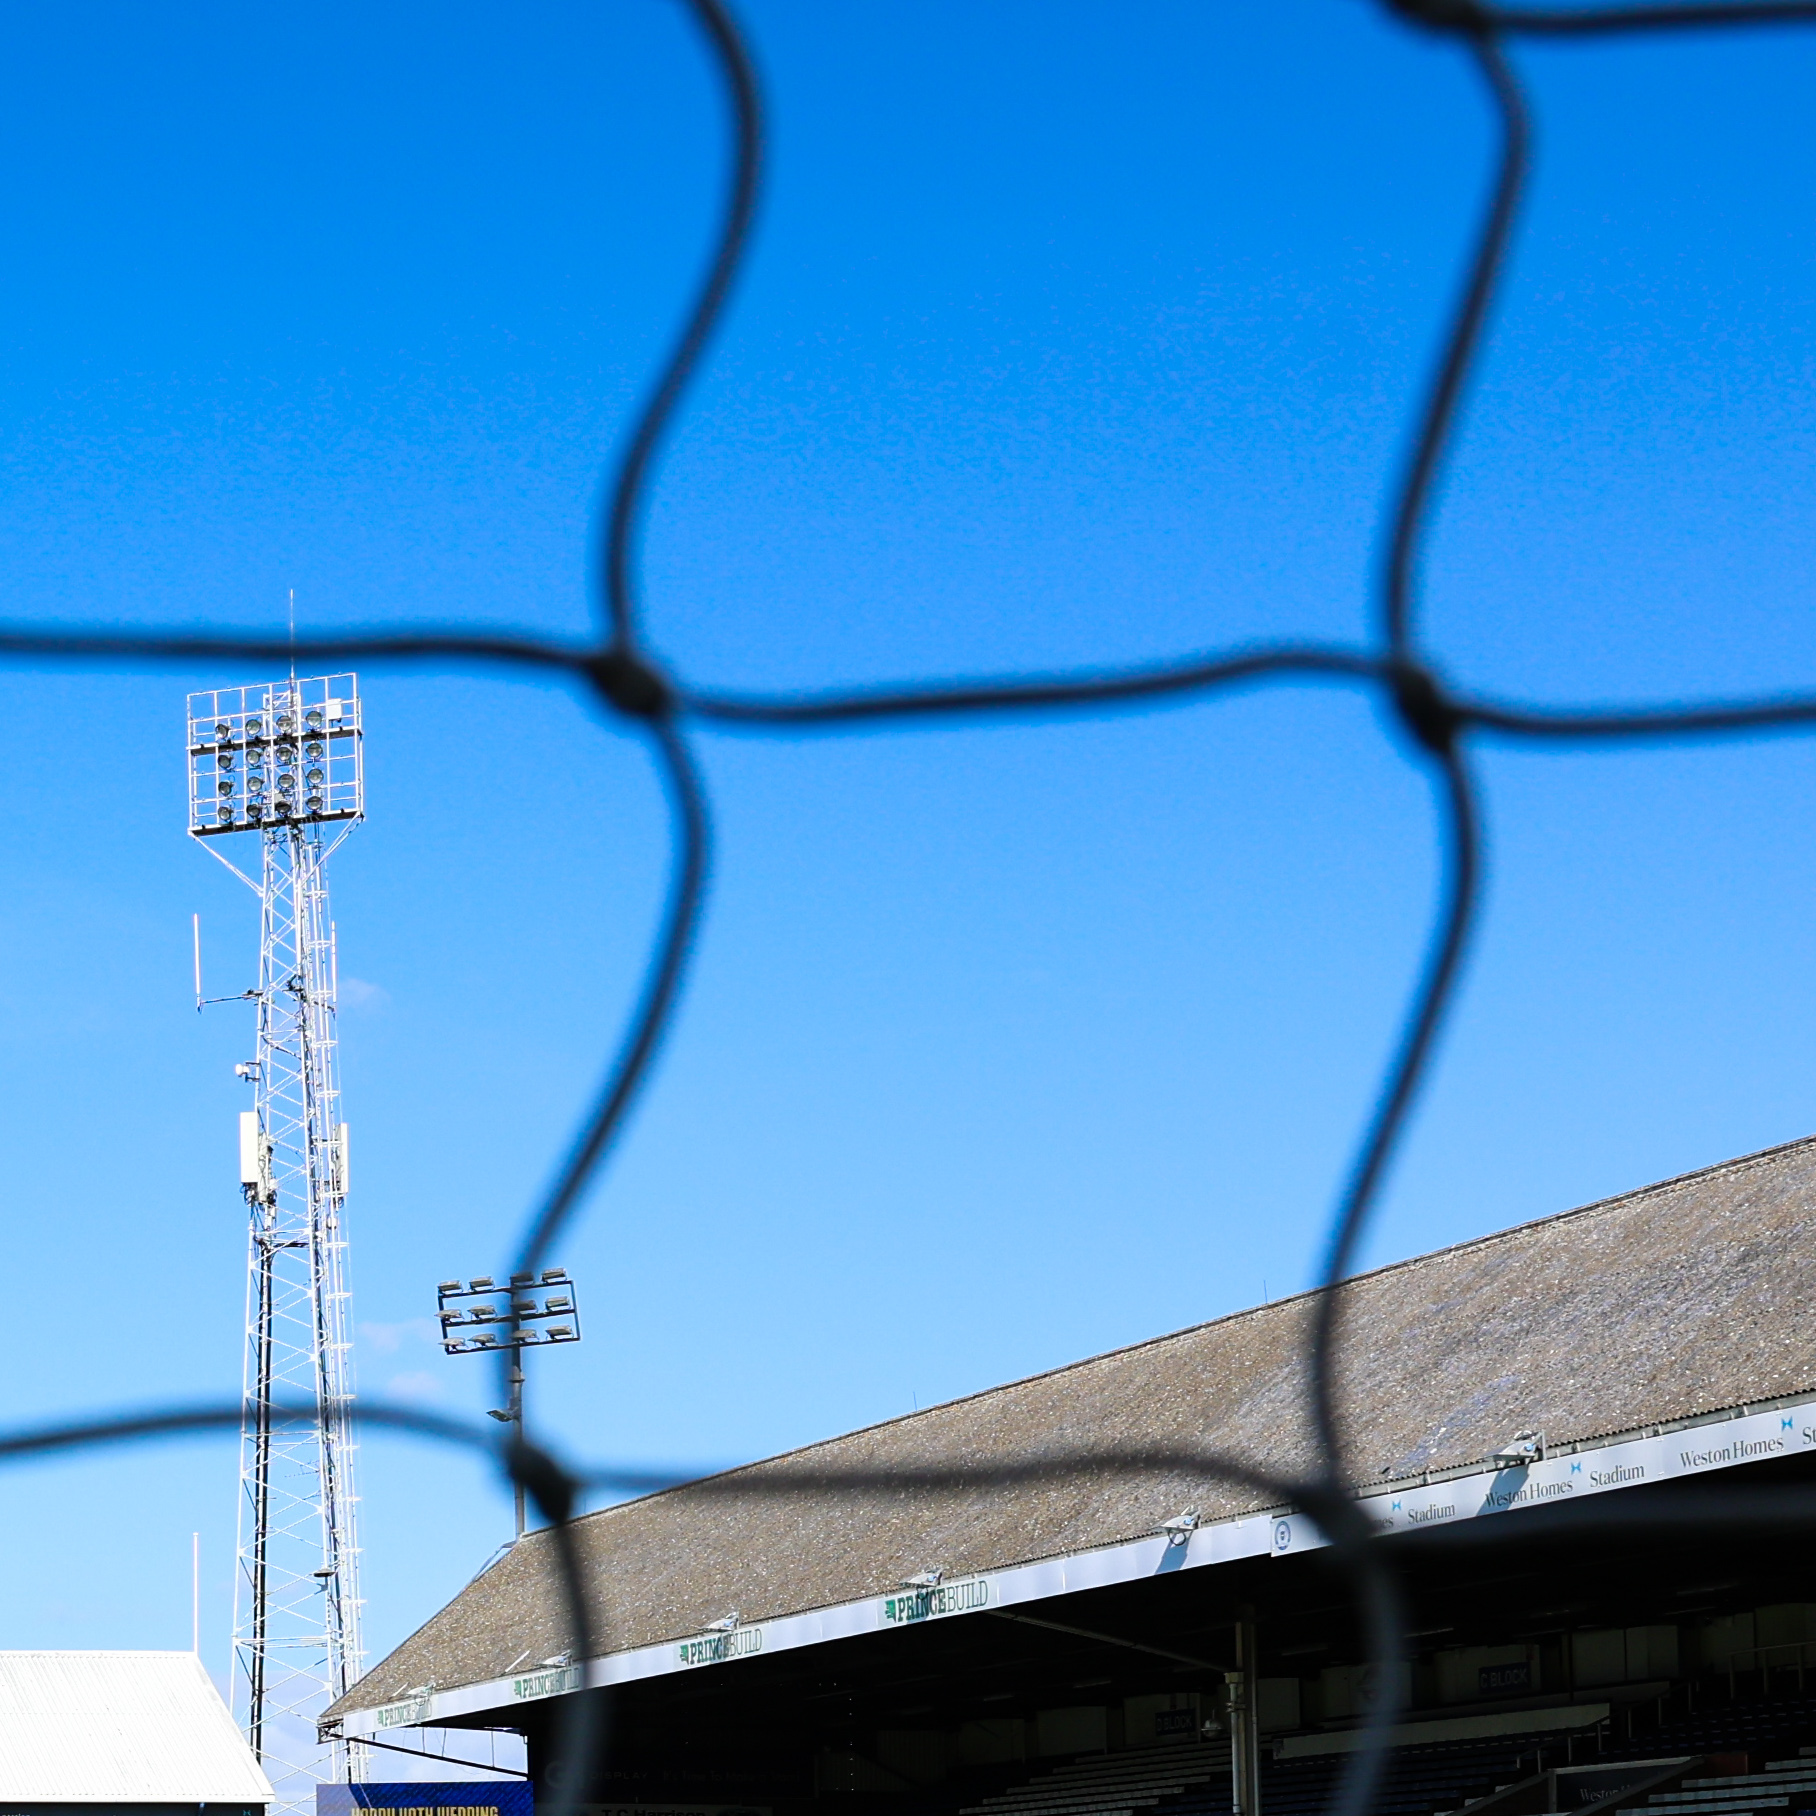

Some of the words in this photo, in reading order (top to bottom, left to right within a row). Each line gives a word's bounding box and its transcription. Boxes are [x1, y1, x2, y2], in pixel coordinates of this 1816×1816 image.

[1680, 1445, 1731, 1468] Weston
[1733, 1437, 1784, 1460] Homes
[1589, 1464, 1646, 1488] Stadium
[1485, 1488, 1527, 1508] Weston
[1530, 1479, 1573, 1500] Homes
[1408, 1503, 1456, 1525] Stadium
[898, 1579, 988, 1623] PRINCEBUILD
[690, 1628, 763, 1666] PRINCEBUILD
[1480, 1673, 1488, 1688] C
[1490, 1668, 1528, 1687] BLOCK
